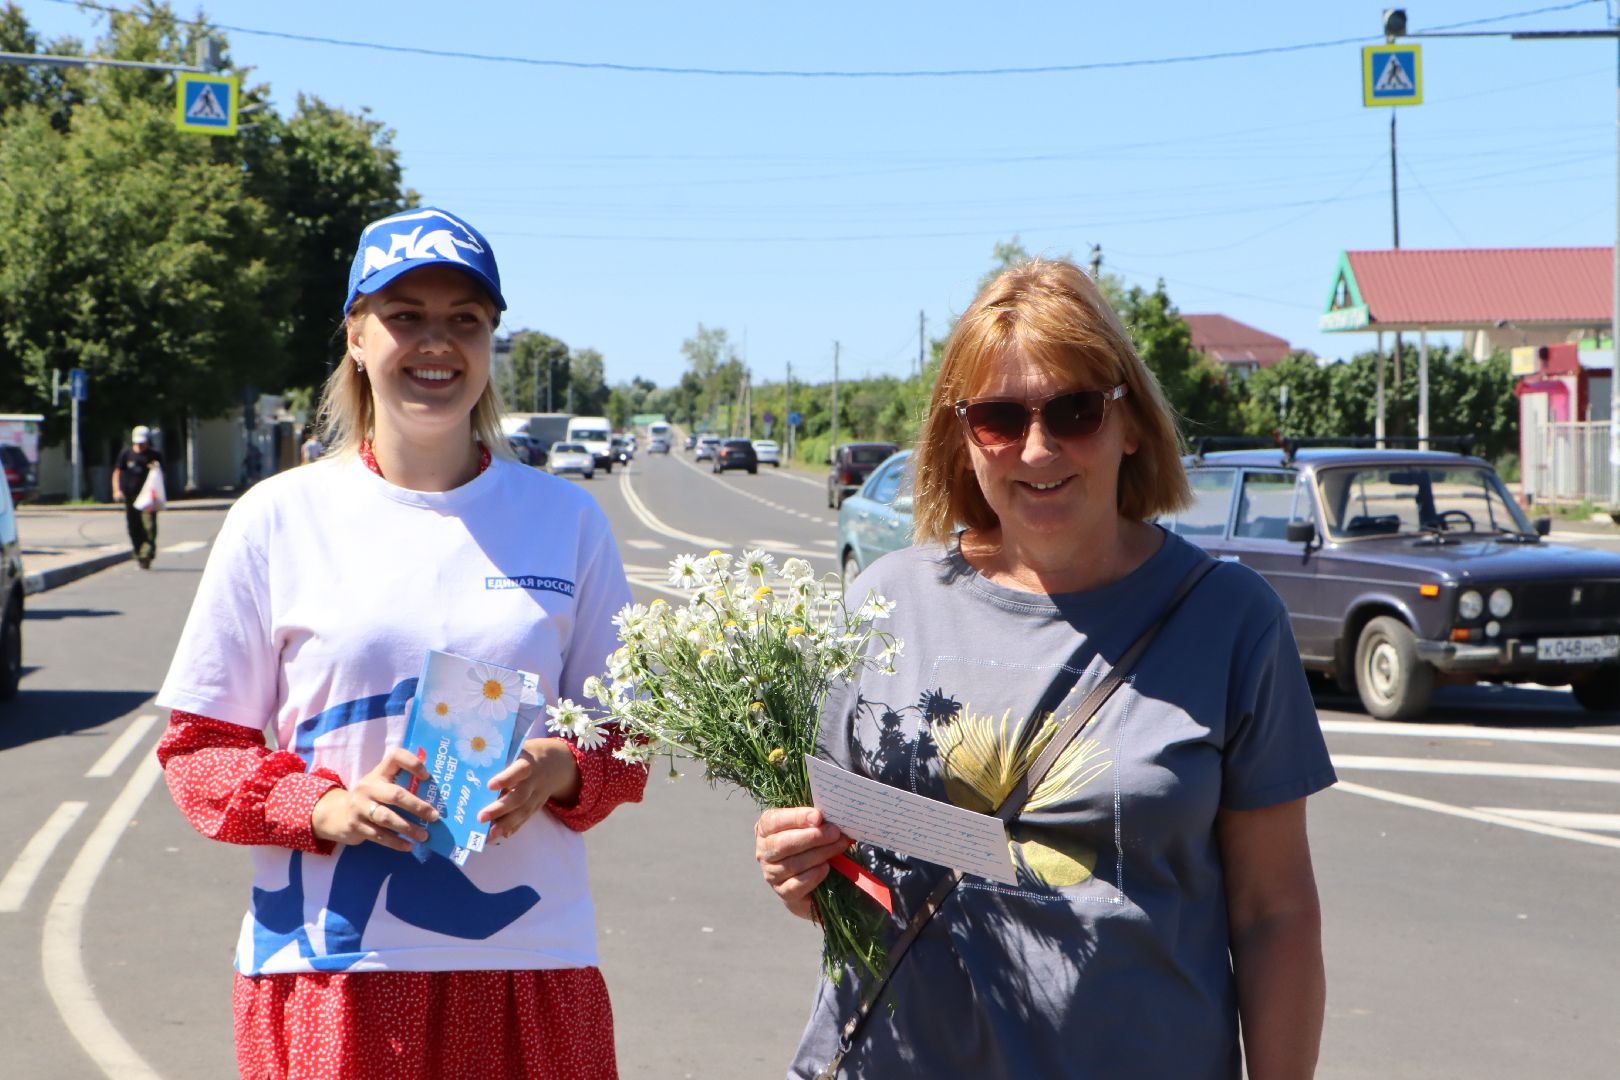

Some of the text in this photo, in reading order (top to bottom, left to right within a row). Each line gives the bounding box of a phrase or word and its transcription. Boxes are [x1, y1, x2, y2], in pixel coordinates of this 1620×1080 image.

[487, 578, 534, 589] ЕДИНАЯ
[433, 736, 450, 774] ЛЮБВИ
[432, 773, 442, 784] И
[444, 756, 457, 782] ДЕНЬ
[466, 769, 481, 788] 8
